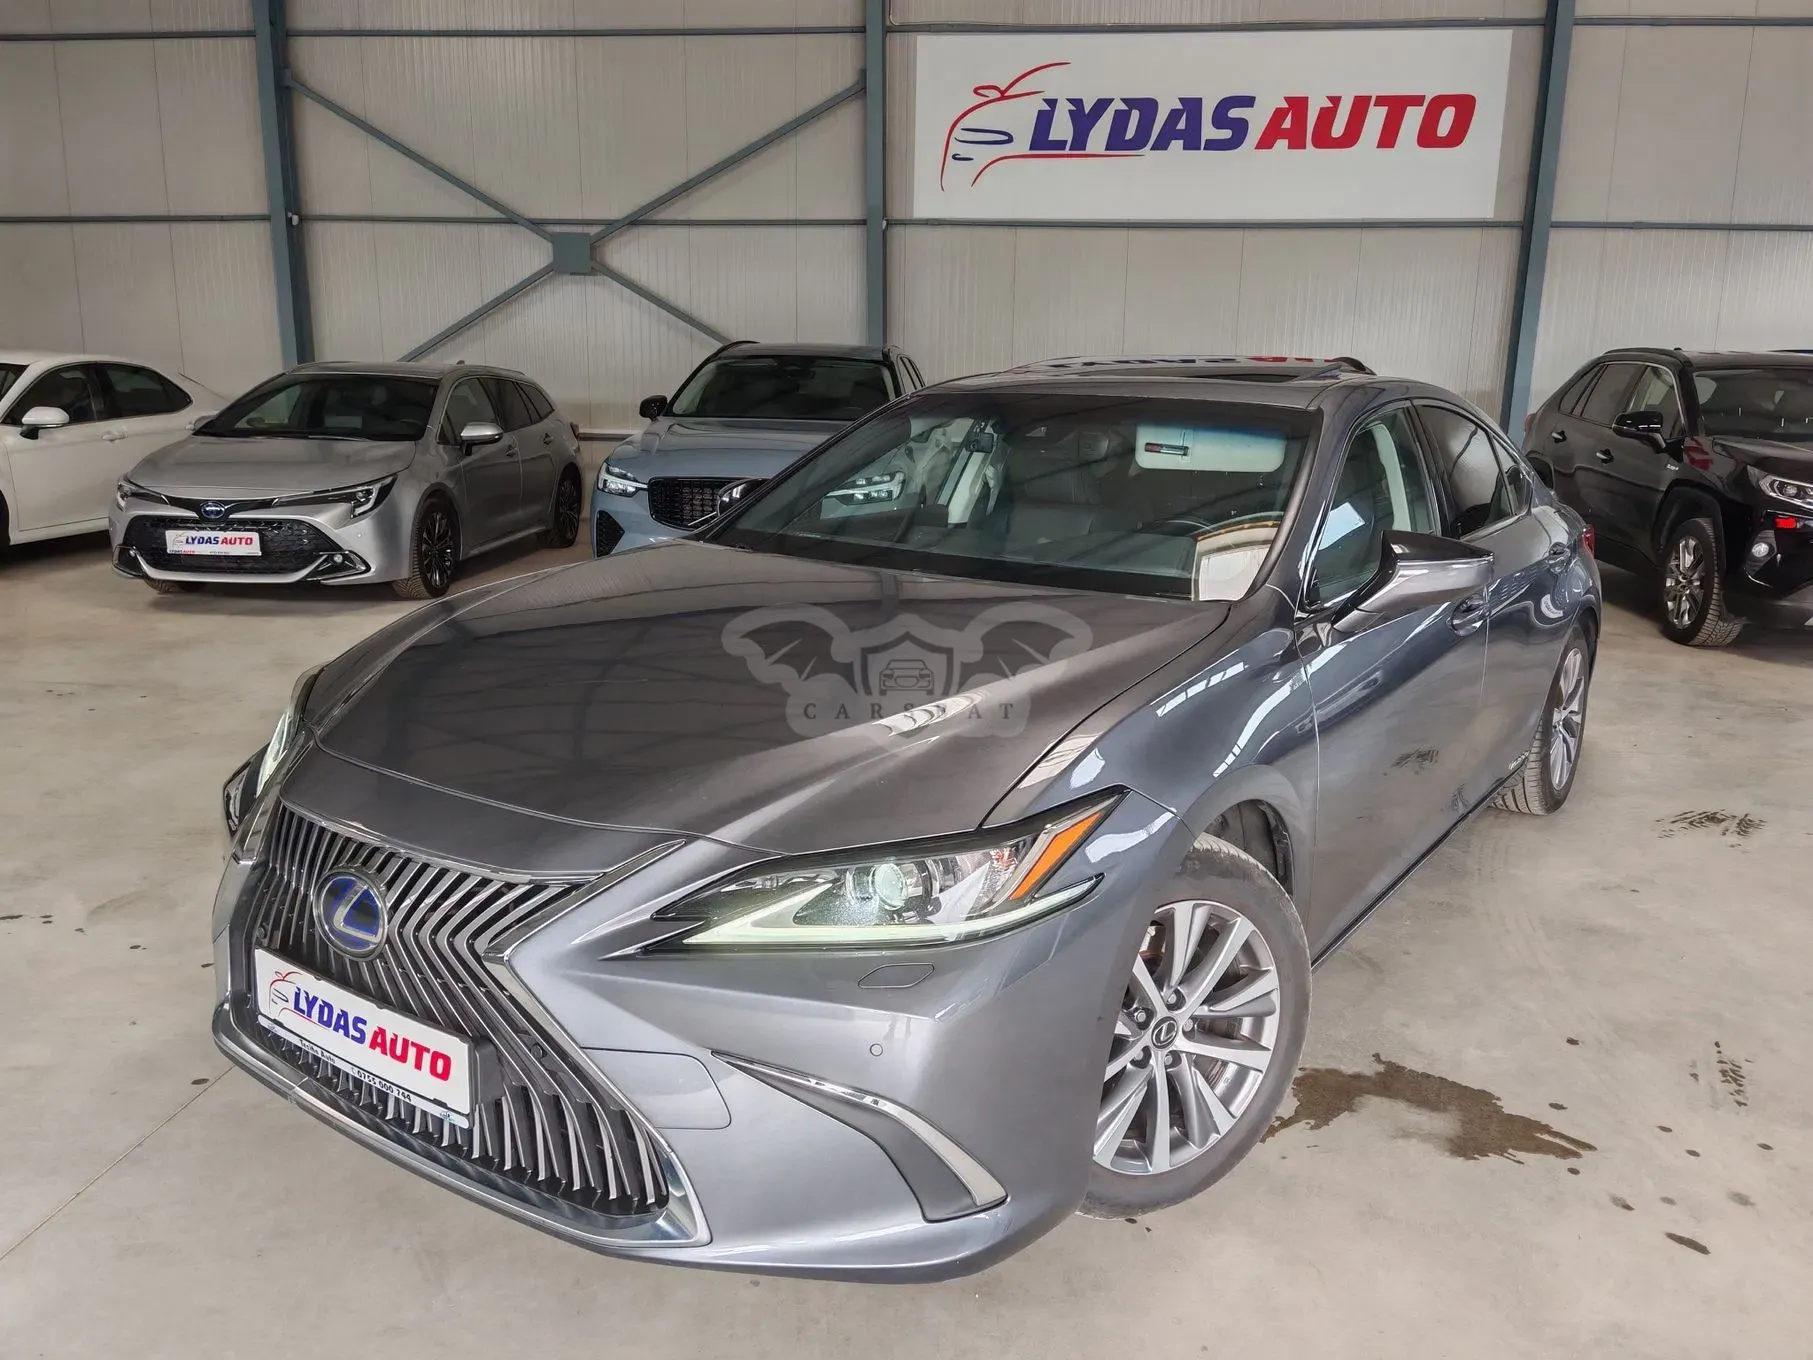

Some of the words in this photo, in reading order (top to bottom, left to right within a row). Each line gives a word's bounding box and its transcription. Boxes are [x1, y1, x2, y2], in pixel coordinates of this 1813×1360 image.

[1029, 95, 1257, 152] LYDAS
[1254, 94, 1477, 150] AUTO
[185, 536, 220, 545] LYDAS
[220, 536, 254, 546] AUTO
[293, 986, 368, 1045] LYDAS
[369, 1026, 452, 1082] AUTO
[357, 1069, 377, 1086] 0755
[378, 1080, 394, 1094] 000
